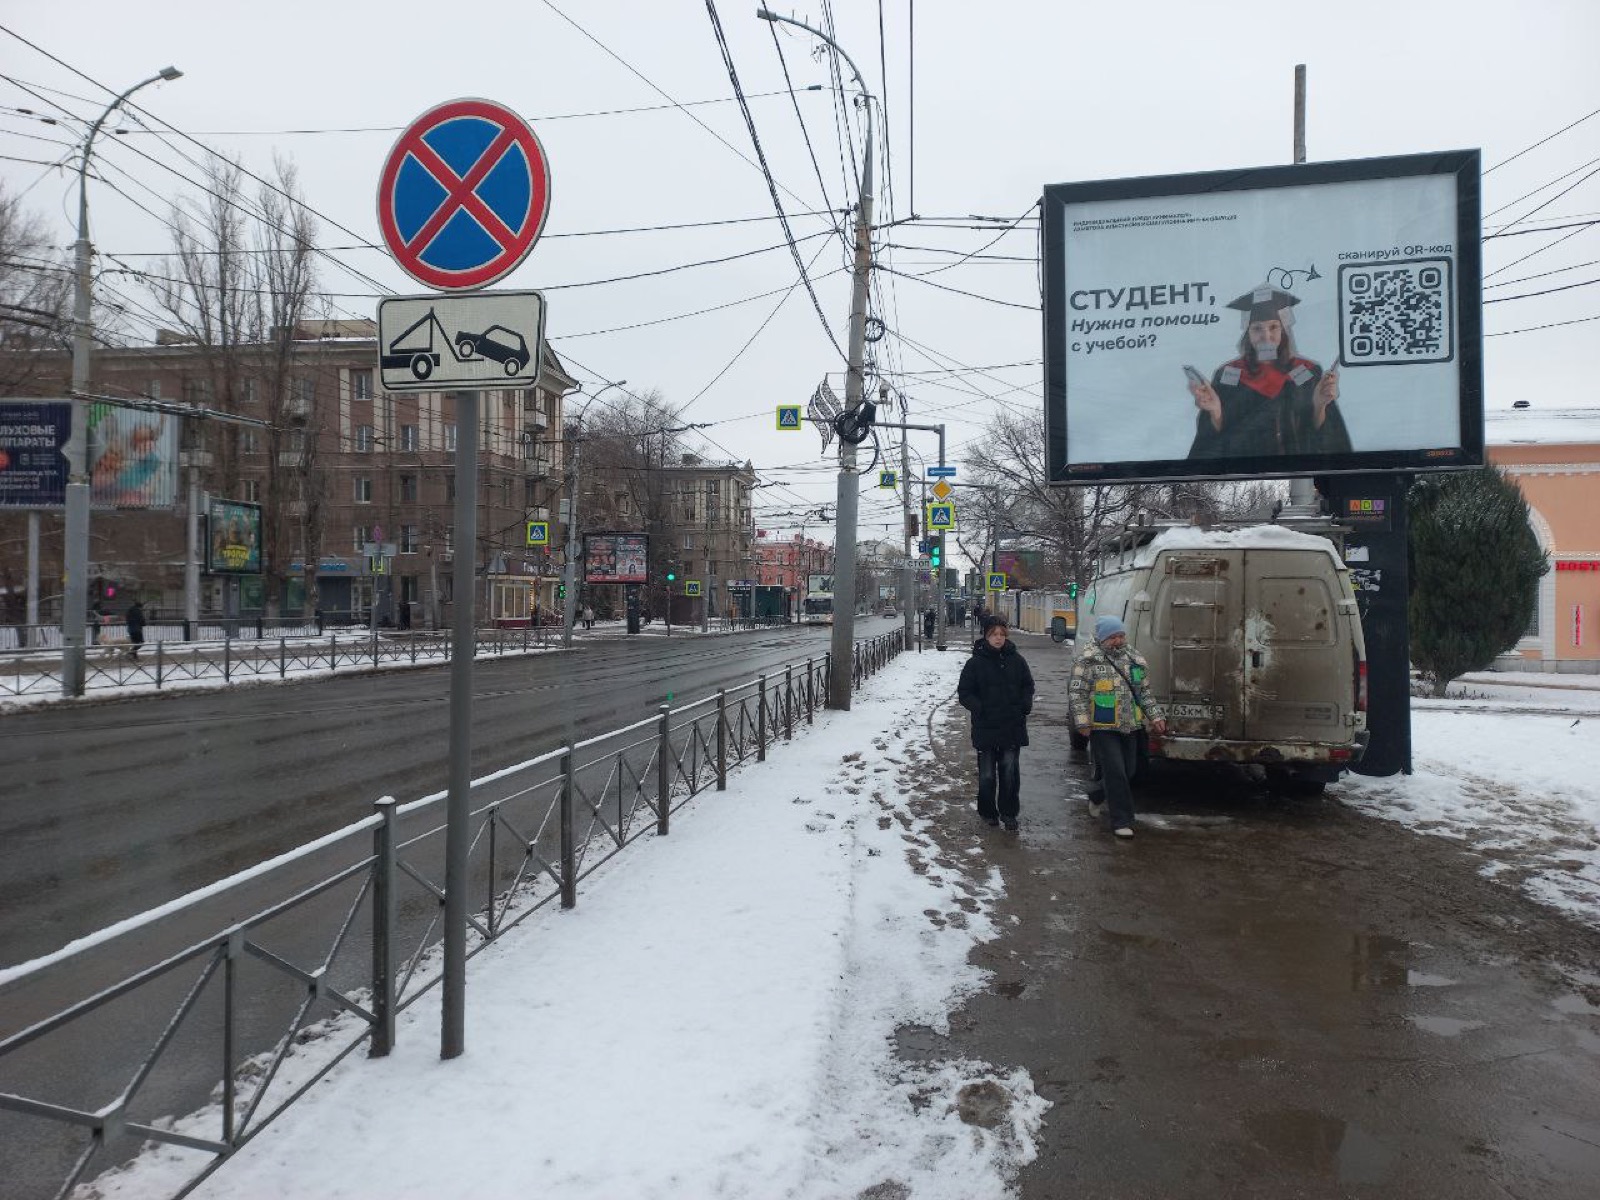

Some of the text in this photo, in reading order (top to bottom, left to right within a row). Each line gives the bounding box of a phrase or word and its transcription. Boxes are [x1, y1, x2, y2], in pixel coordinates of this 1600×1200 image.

[1338, 244, 1452, 260] сканируй QR-код
[1069, 281, 1216, 311] СТУДЕНТ,
[1071, 312, 1220, 334] Нужна помощь
[1071, 334, 1157, 355] с учебой?
[907, 560, 930, 568] СТОП
